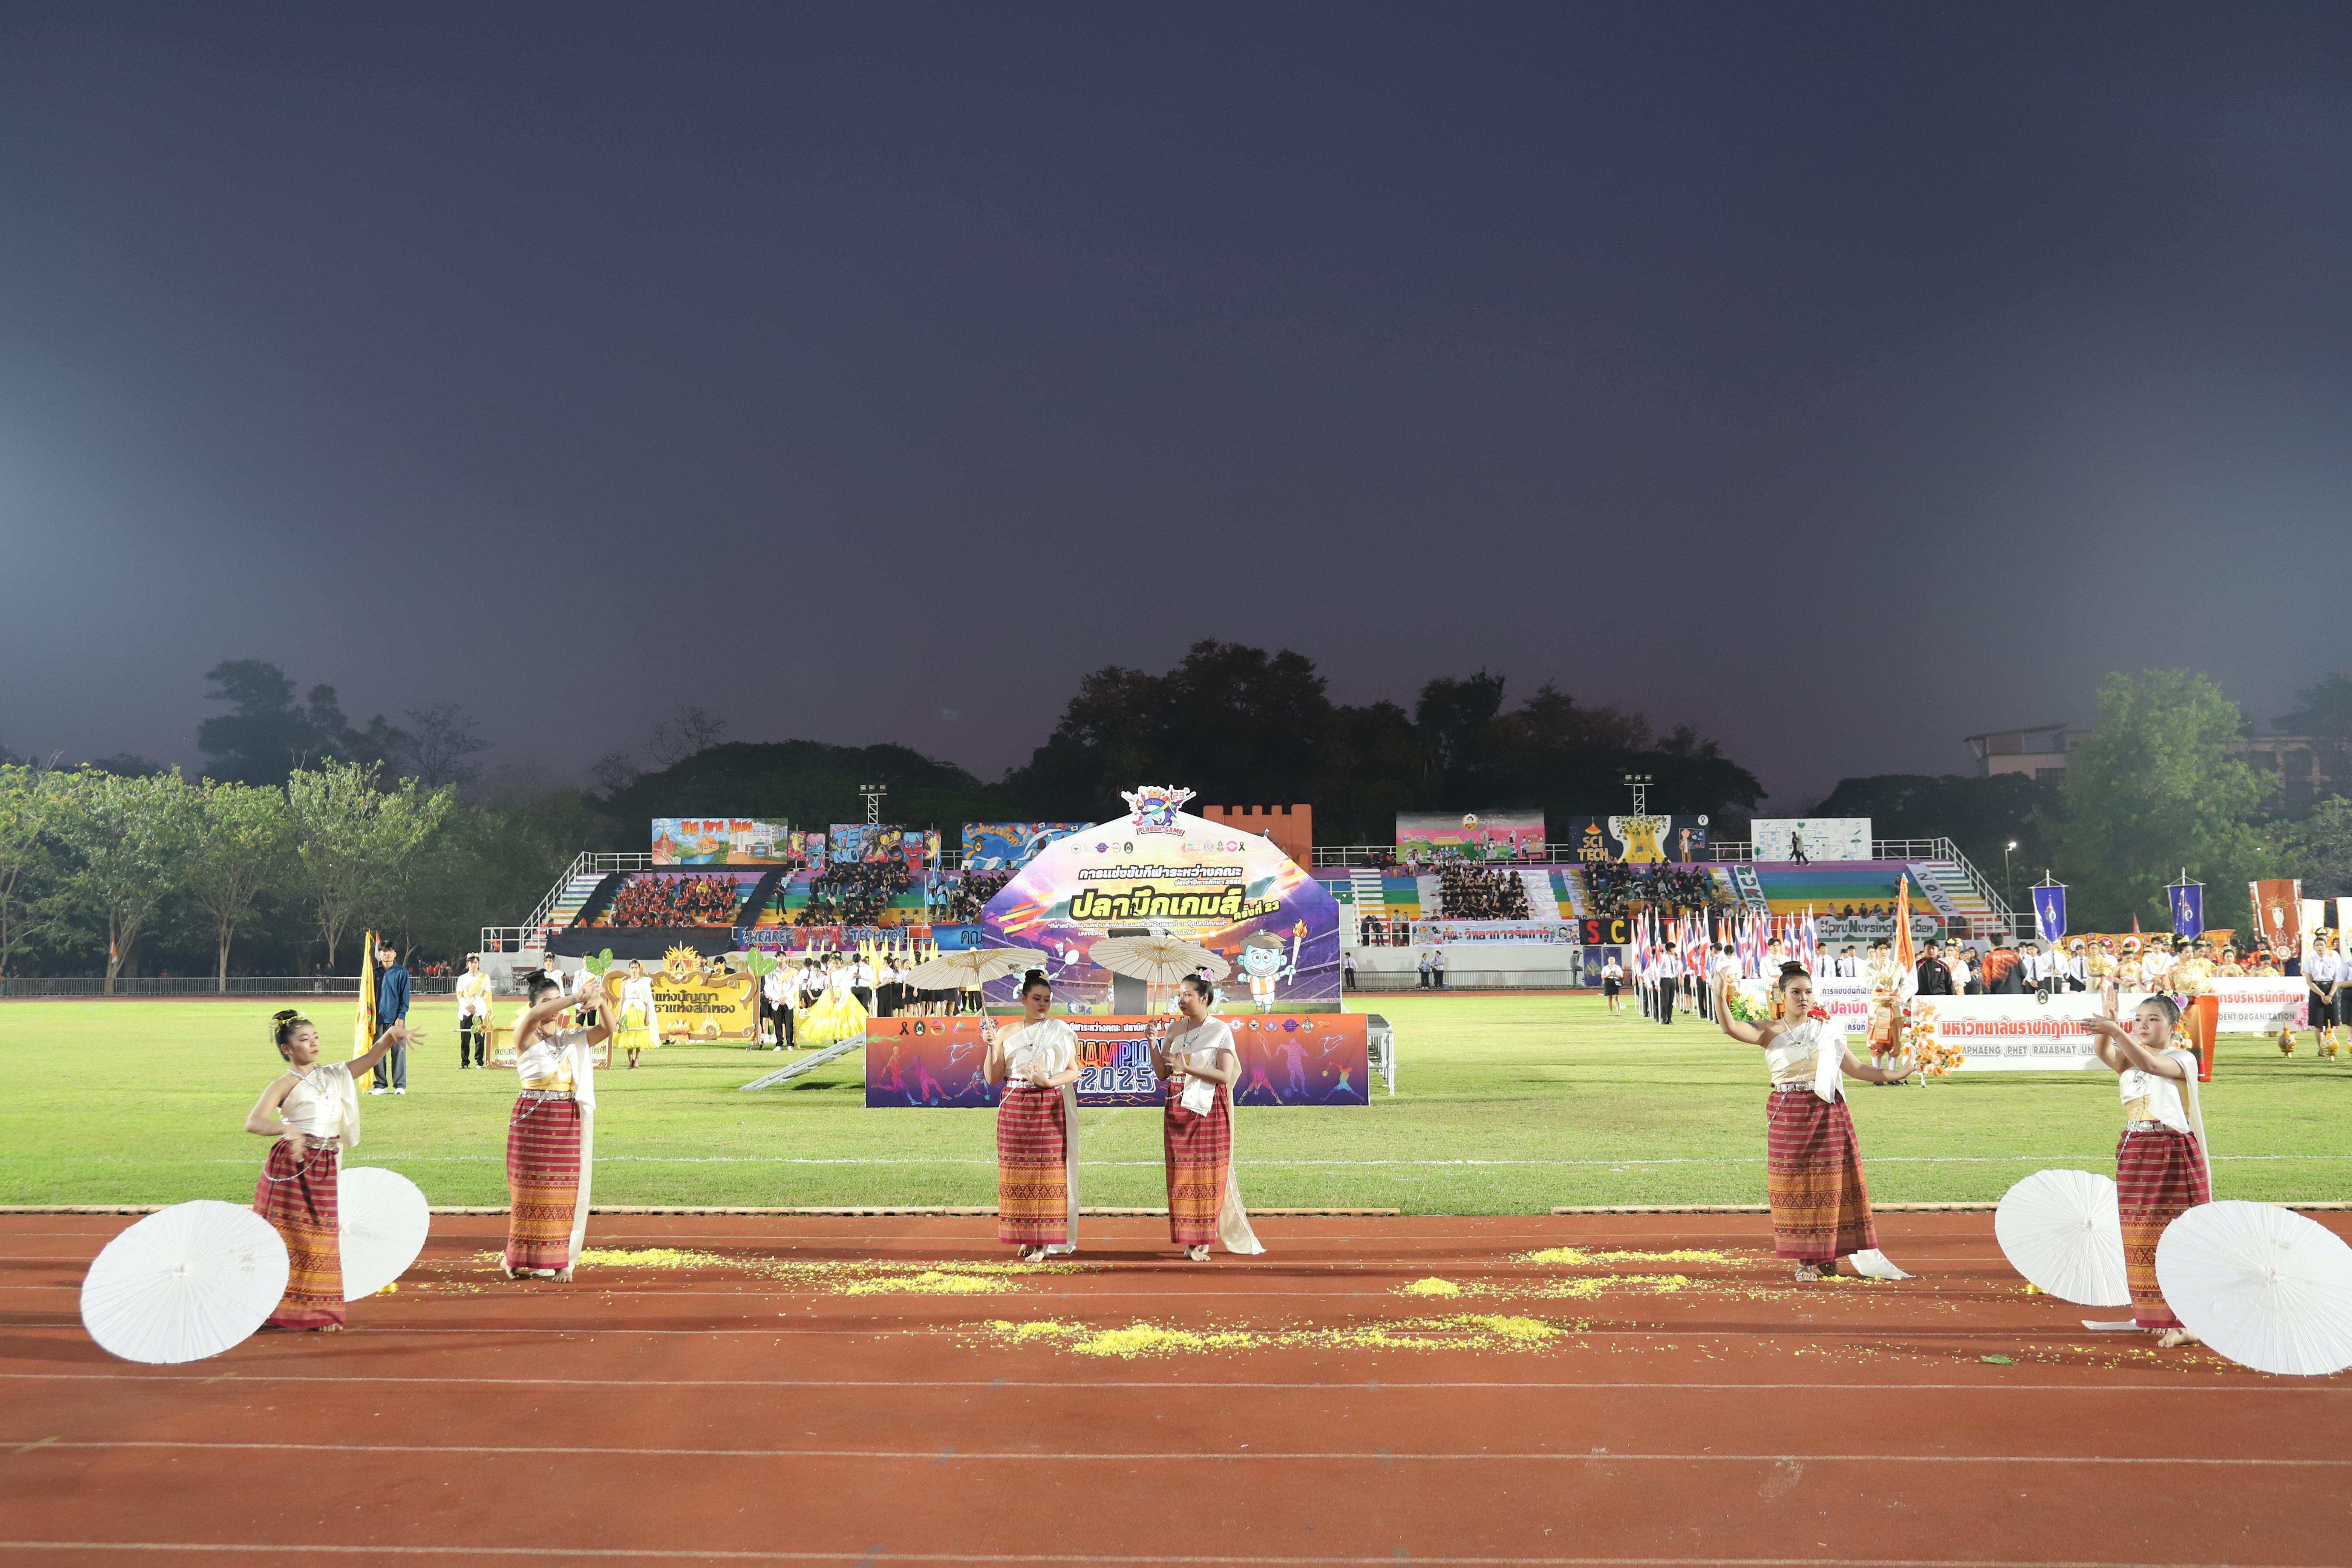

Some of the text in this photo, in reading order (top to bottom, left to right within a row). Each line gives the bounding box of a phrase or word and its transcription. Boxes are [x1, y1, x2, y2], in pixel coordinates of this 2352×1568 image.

[965, 823, 1020, 846] Education
[1165, 827, 1184, 835] GAME
[1583, 836, 1603, 848] SCI
[1577, 848, 1609, 862] TECH
[1079, 864, 1242, 880] การแข่งขันกีฬาระหว่างคณะ
[1071, 887, 1243, 917] ปลาบึกเกมส์
[1233, 900, 1280, 920] ครั้งที่ 23
[1849, 920, 1893, 937] Nursing
[1443, 931, 1463, 940] คณะ
[1822, 986, 1871, 994] การแข่งขันกีฬา
[2218, 990, 2304, 1003] การบริหารนักศึกษา
[2238, 1012, 2295, 1021] ORGANIZATION
[2007, 1046, 2028, 1054] PHET
[2033, 1046, 2076, 1054] RAJABHAT
[1078, 1066, 1156, 1093] 2025
